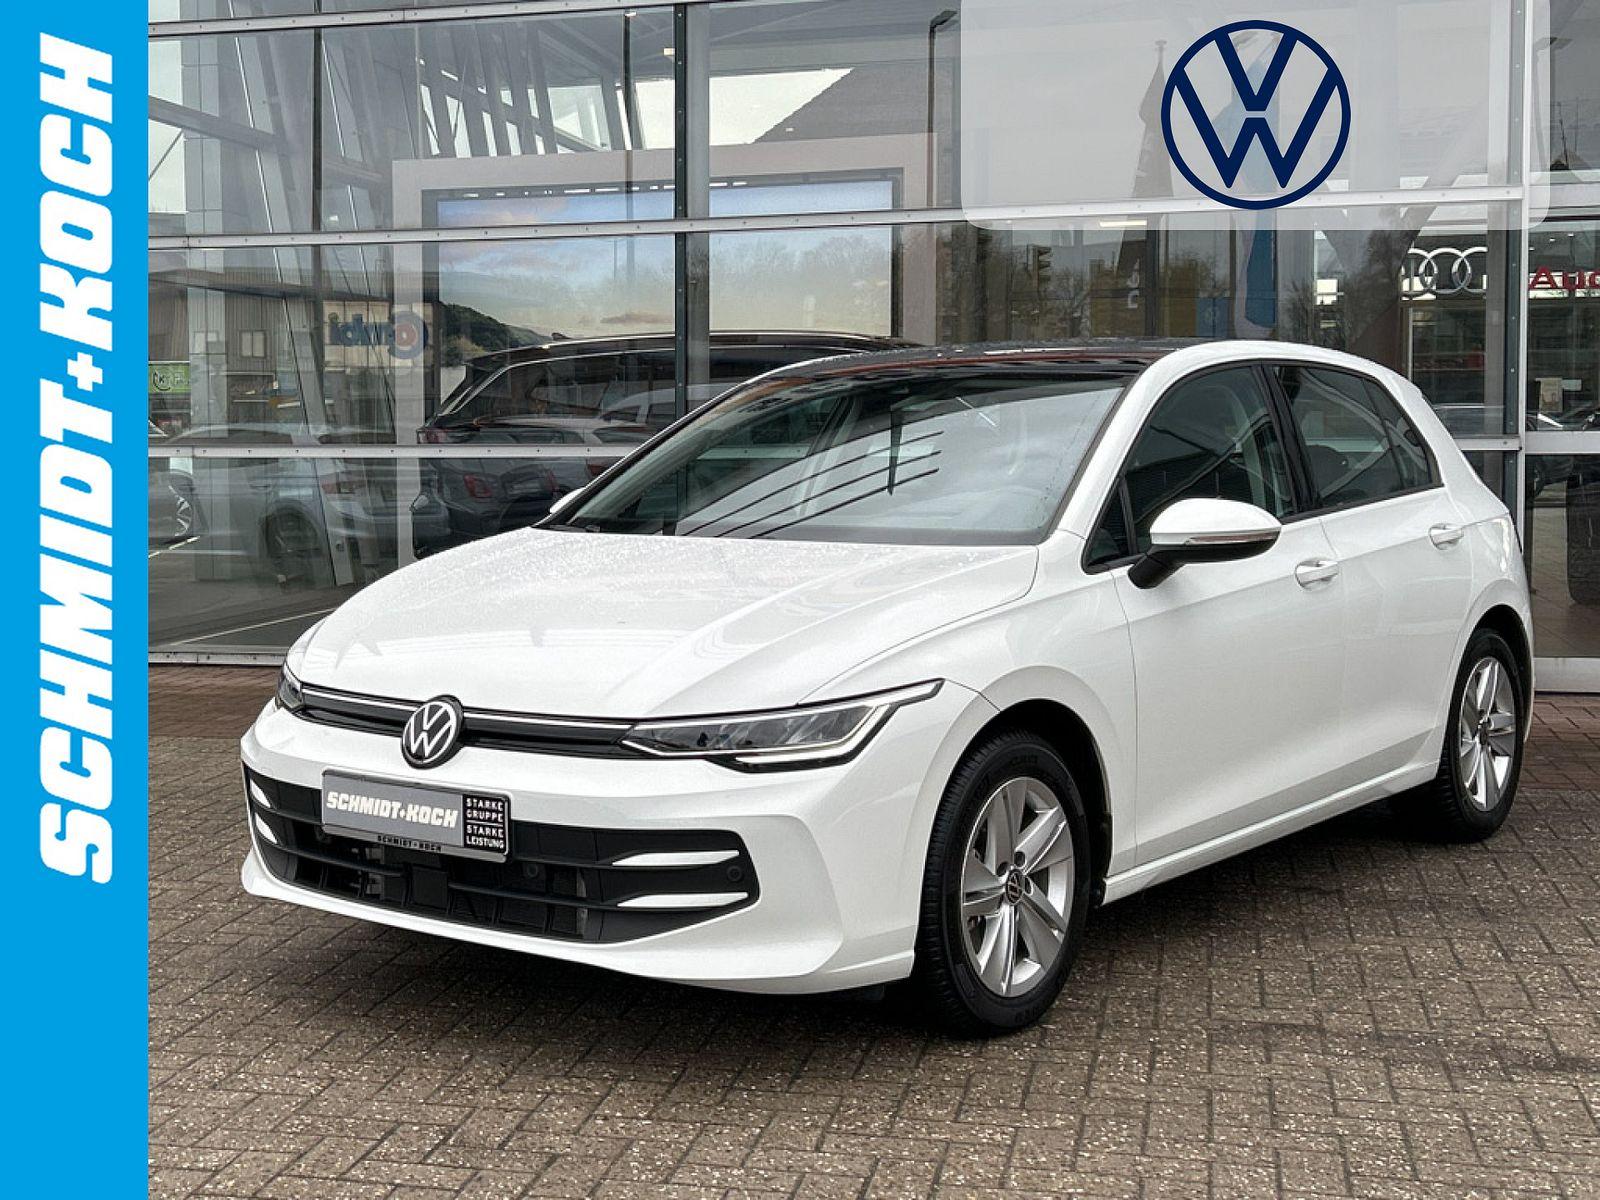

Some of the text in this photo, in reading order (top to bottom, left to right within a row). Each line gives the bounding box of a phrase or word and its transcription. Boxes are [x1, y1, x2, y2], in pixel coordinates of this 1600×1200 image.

[466, 797, 503, 812] STARKE
[466, 808, 504, 823] GRUPPE
[466, 824, 504, 838] STARKE
